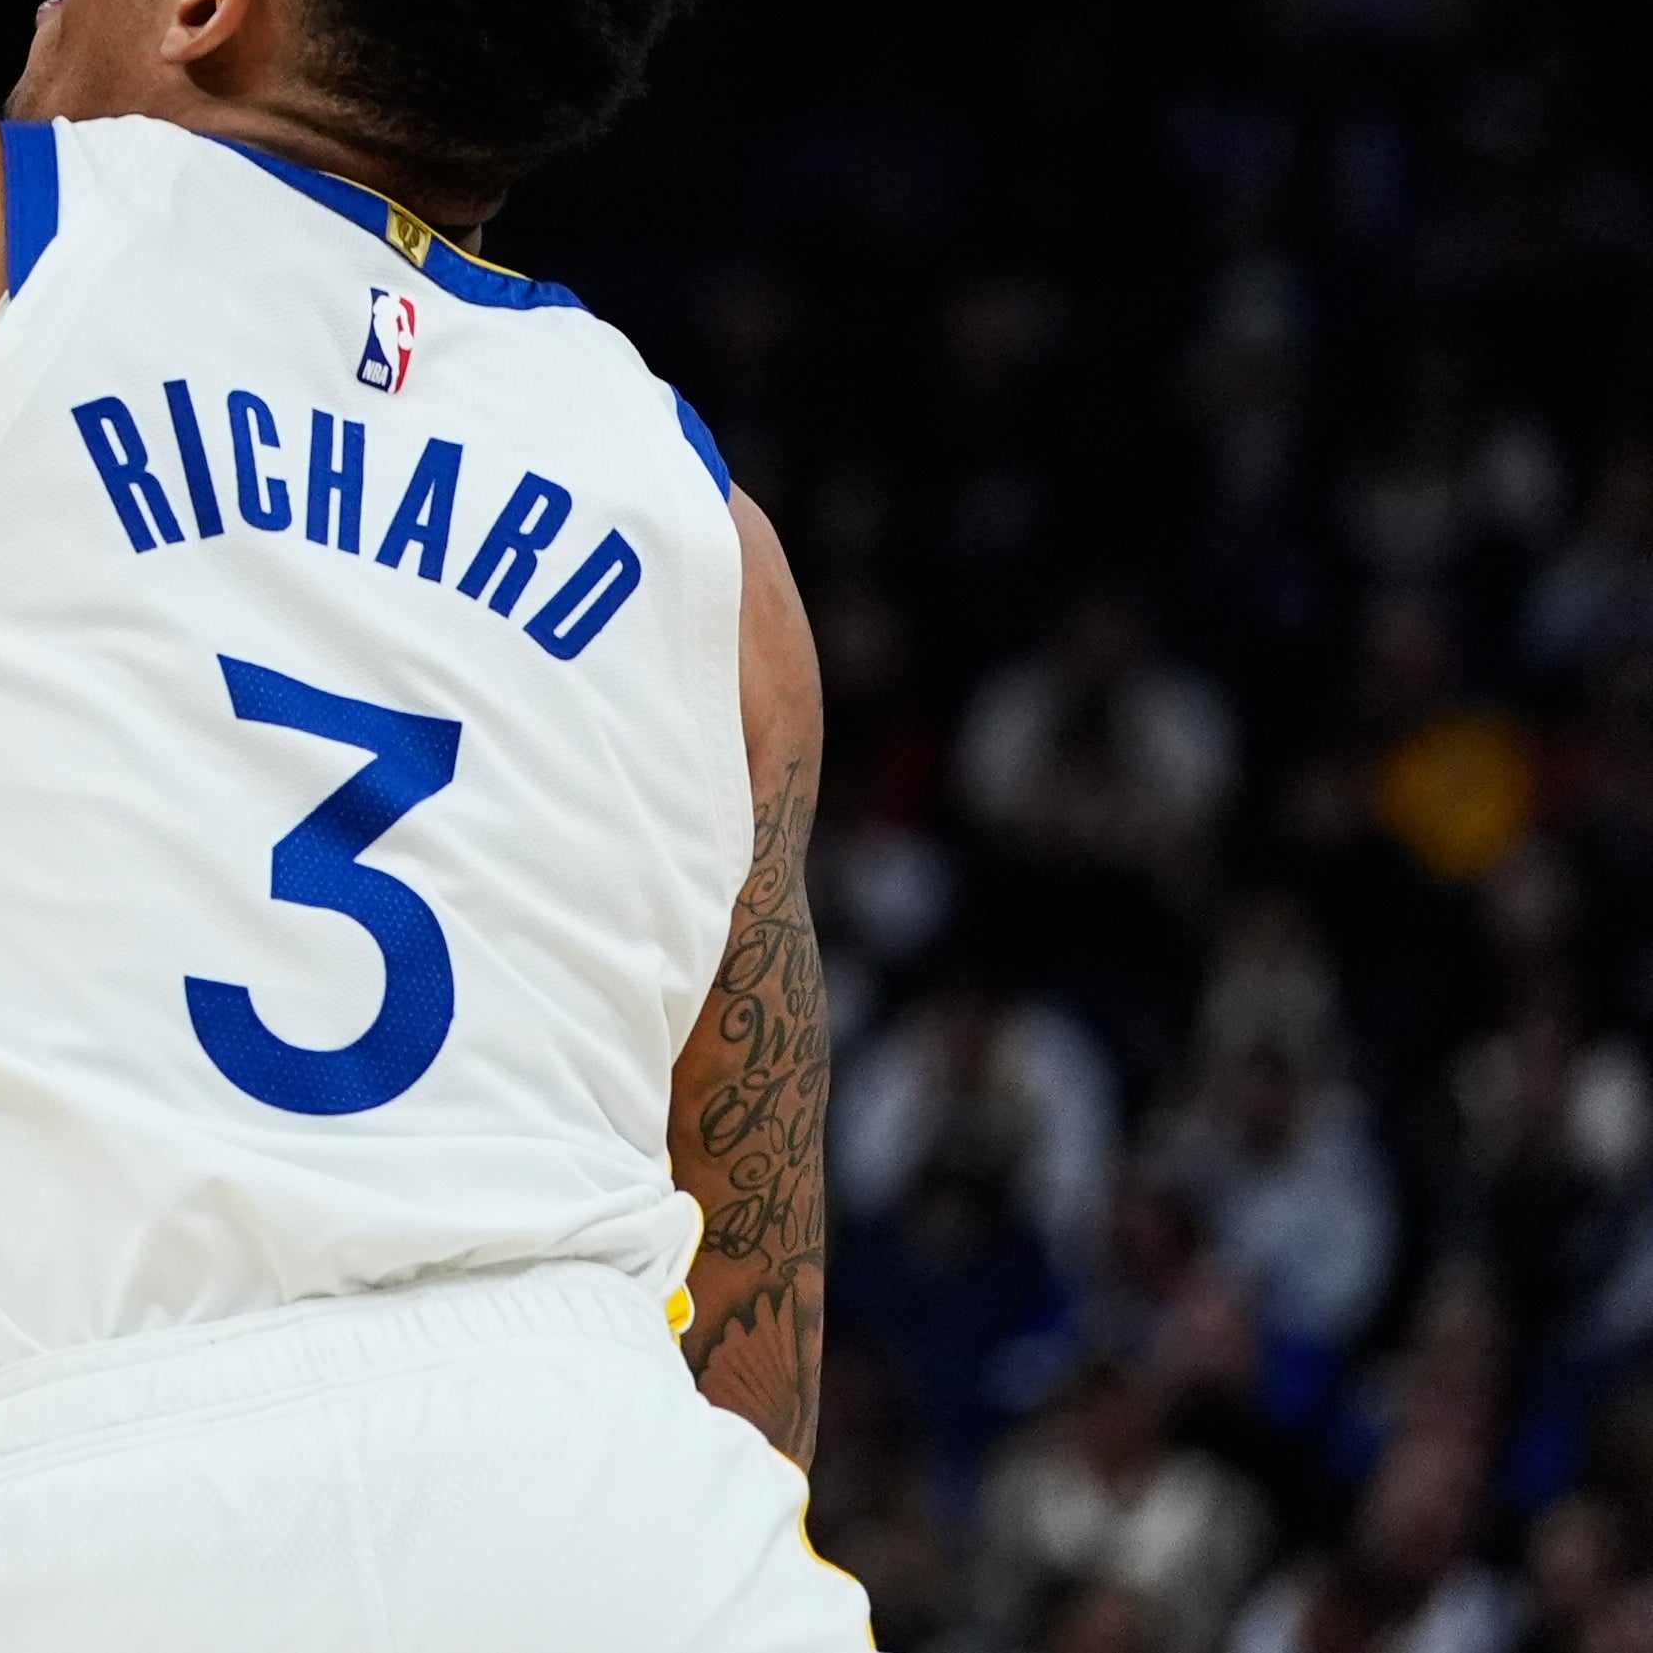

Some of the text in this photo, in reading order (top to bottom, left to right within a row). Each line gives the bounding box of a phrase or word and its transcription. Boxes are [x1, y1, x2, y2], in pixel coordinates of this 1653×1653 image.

[362, 358, 390, 386] NBA
[70, 379, 643, 662] RICHARD
[183, 652, 463, 1117] 3
